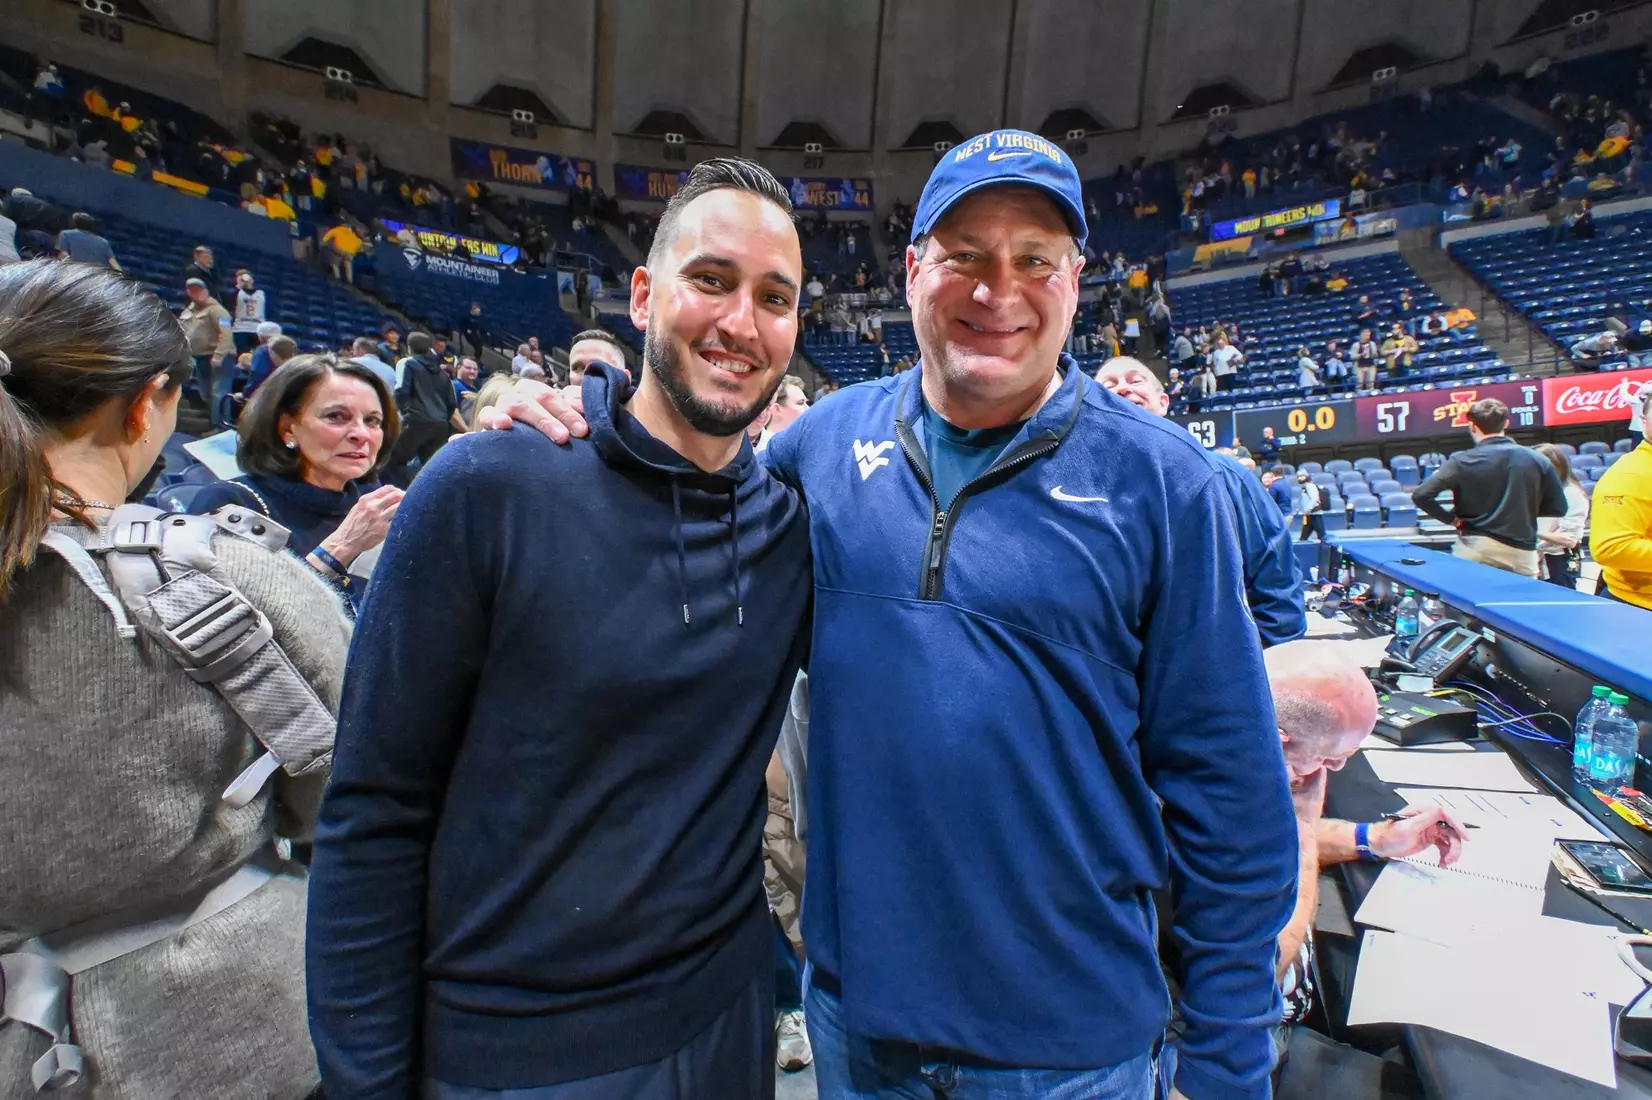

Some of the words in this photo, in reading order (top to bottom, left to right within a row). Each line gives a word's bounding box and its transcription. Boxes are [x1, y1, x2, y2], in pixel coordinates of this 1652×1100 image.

[955, 133, 993, 162] WEST
[996, 133, 1062, 165] VIRGINIA
[648, 182, 678, 198] HUN
[426, 255, 500, 278] MOUNTAINEER
[1288, 406, 1335, 432] 0.0
[1376, 401, 1410, 433] 57
[1433, 401, 1473, 422] STA
[1520, 412, 1534, 426] 10
[1188, 420, 1216, 448] 63
[1574, 744, 1592, 763] DAS
[1595, 756, 1632, 778] DASA
